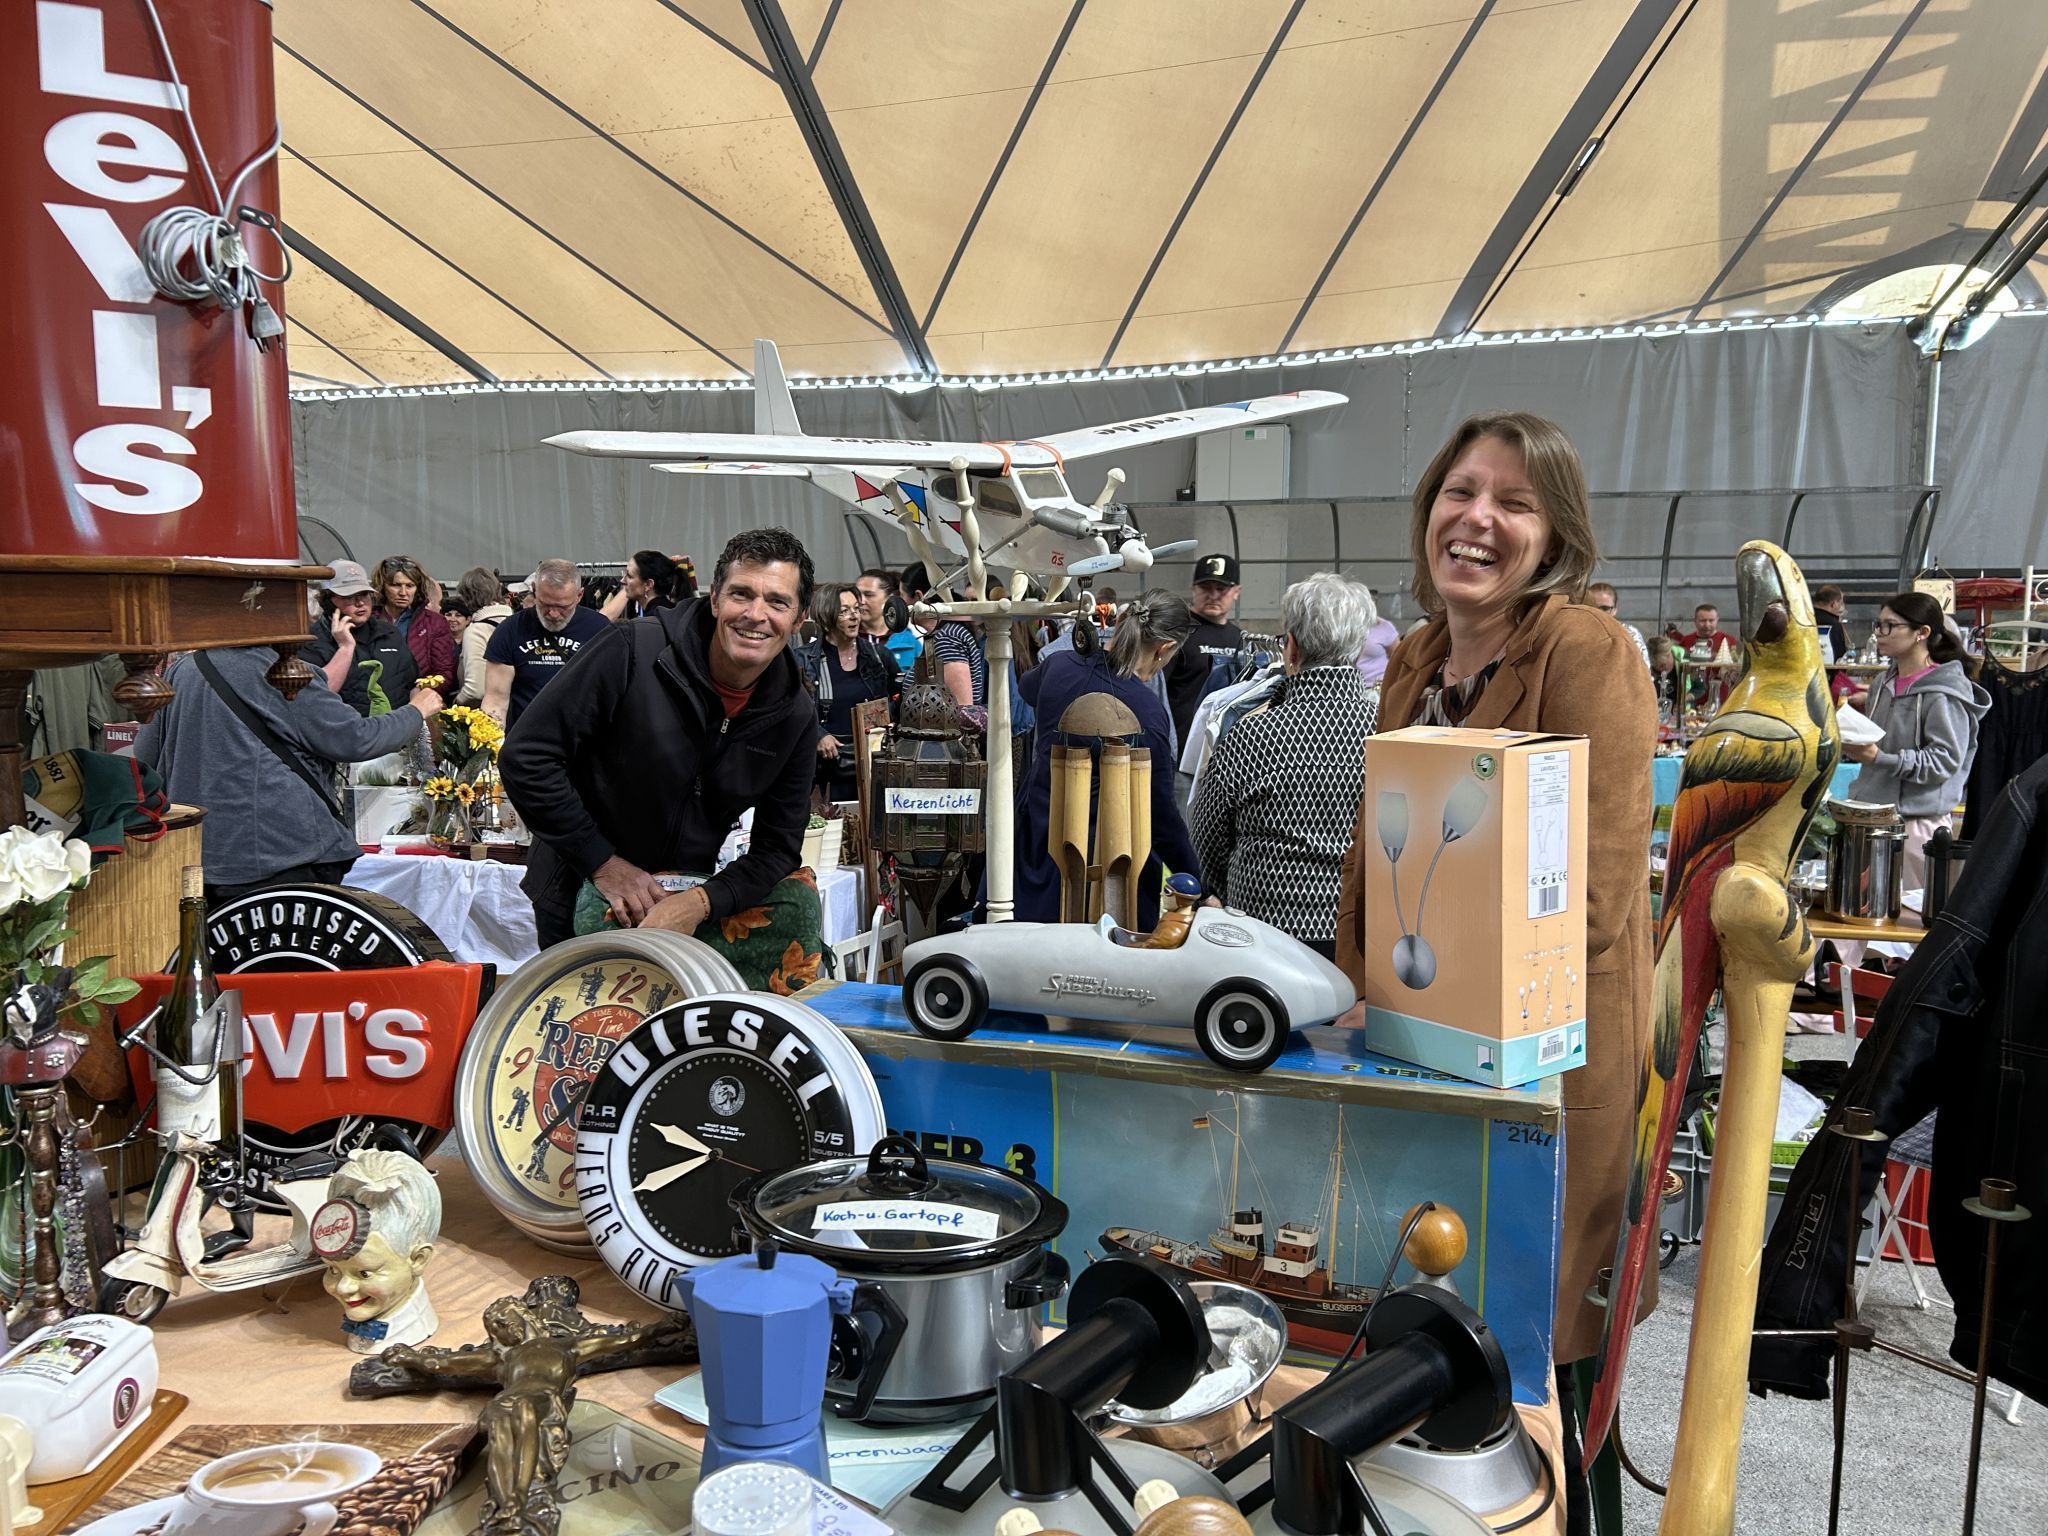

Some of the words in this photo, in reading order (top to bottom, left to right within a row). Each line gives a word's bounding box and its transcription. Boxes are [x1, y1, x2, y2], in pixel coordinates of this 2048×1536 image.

[892, 794, 974, 809] Kerzenlicht
[209, 903, 381, 956] UTHORISED
[230, 932, 342, 962] DEALER
[607, 971, 647, 1004] 12
[593, 1008, 613, 1018] TIME
[509, 1046, 535, 1080] 9
[608, 1006, 832, 1111] DIESEL
[814, 1129, 844, 1146] 5/5
[1508, 1126, 1554, 1147] 2147
[575, 1142, 623, 1248] JEANS
[1280, 1261, 1288, 1272] 3
